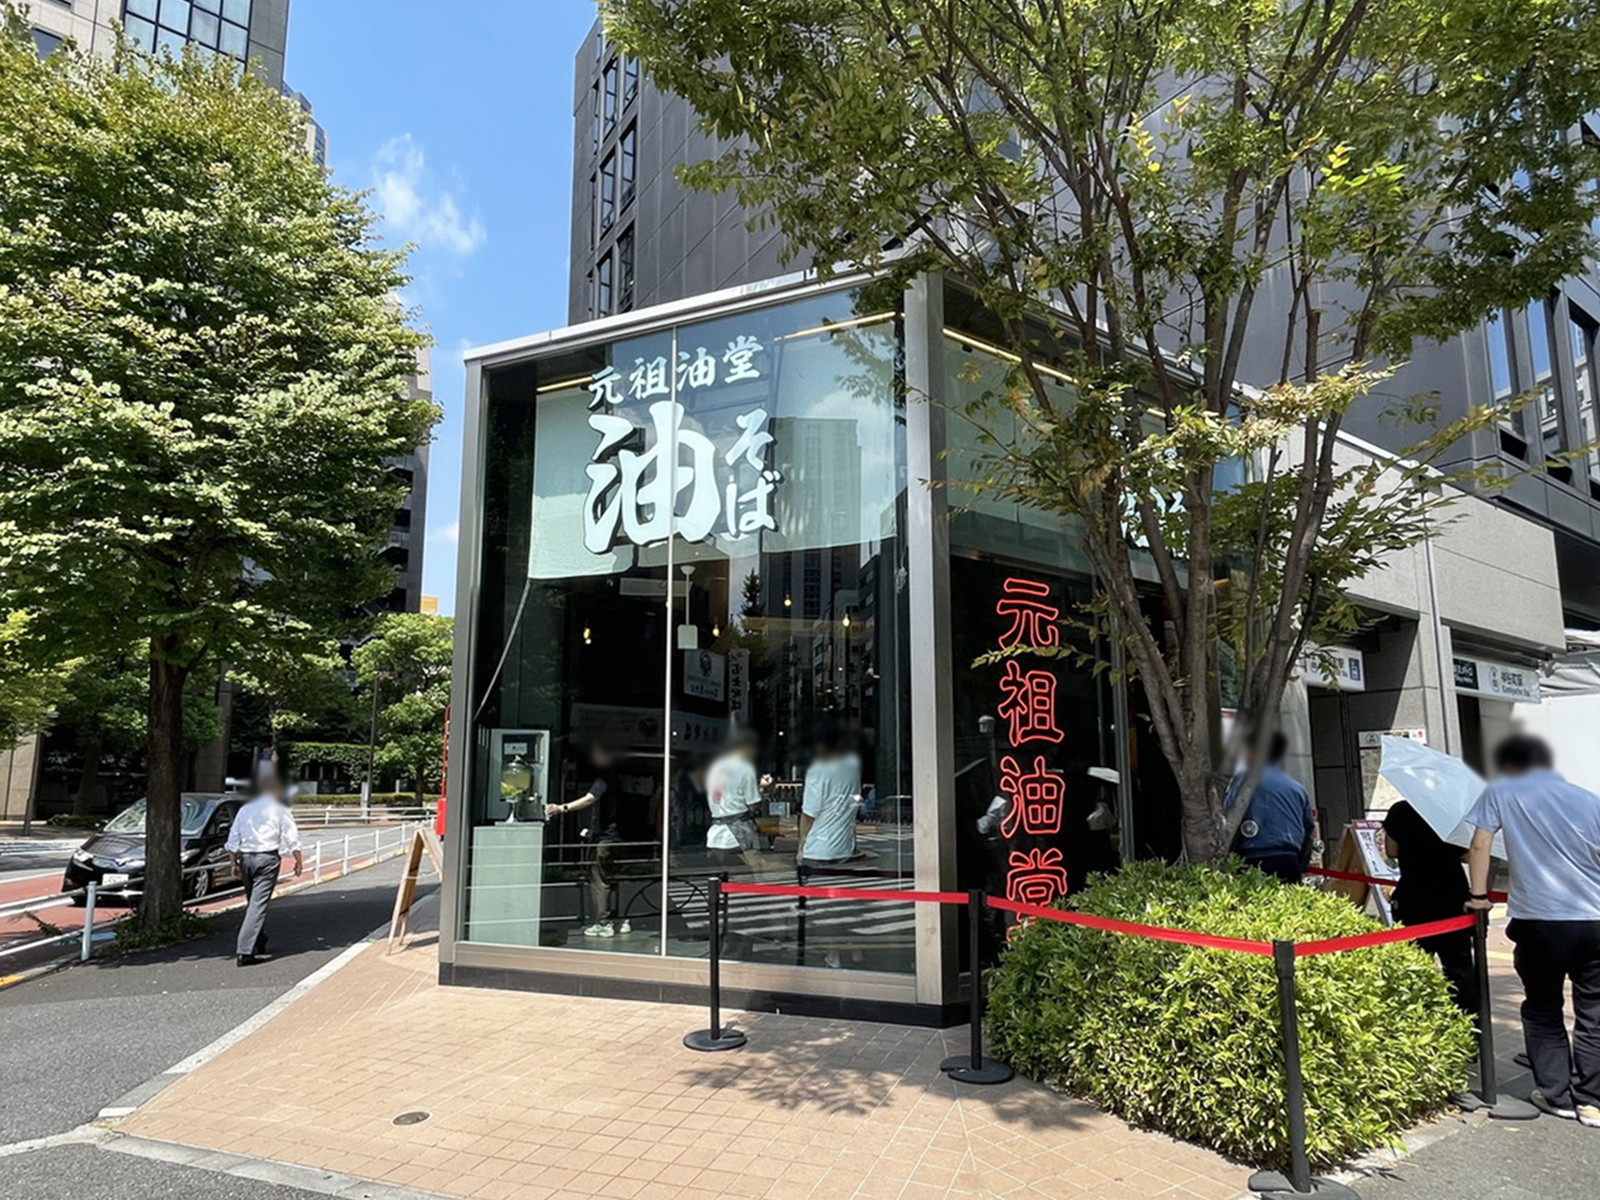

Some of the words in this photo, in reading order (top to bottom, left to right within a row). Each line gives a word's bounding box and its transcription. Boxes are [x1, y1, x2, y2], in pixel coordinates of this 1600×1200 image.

[587, 334, 764, 410] 元祖油堂
[997, 577, 1068, 942] 元祖油堂
